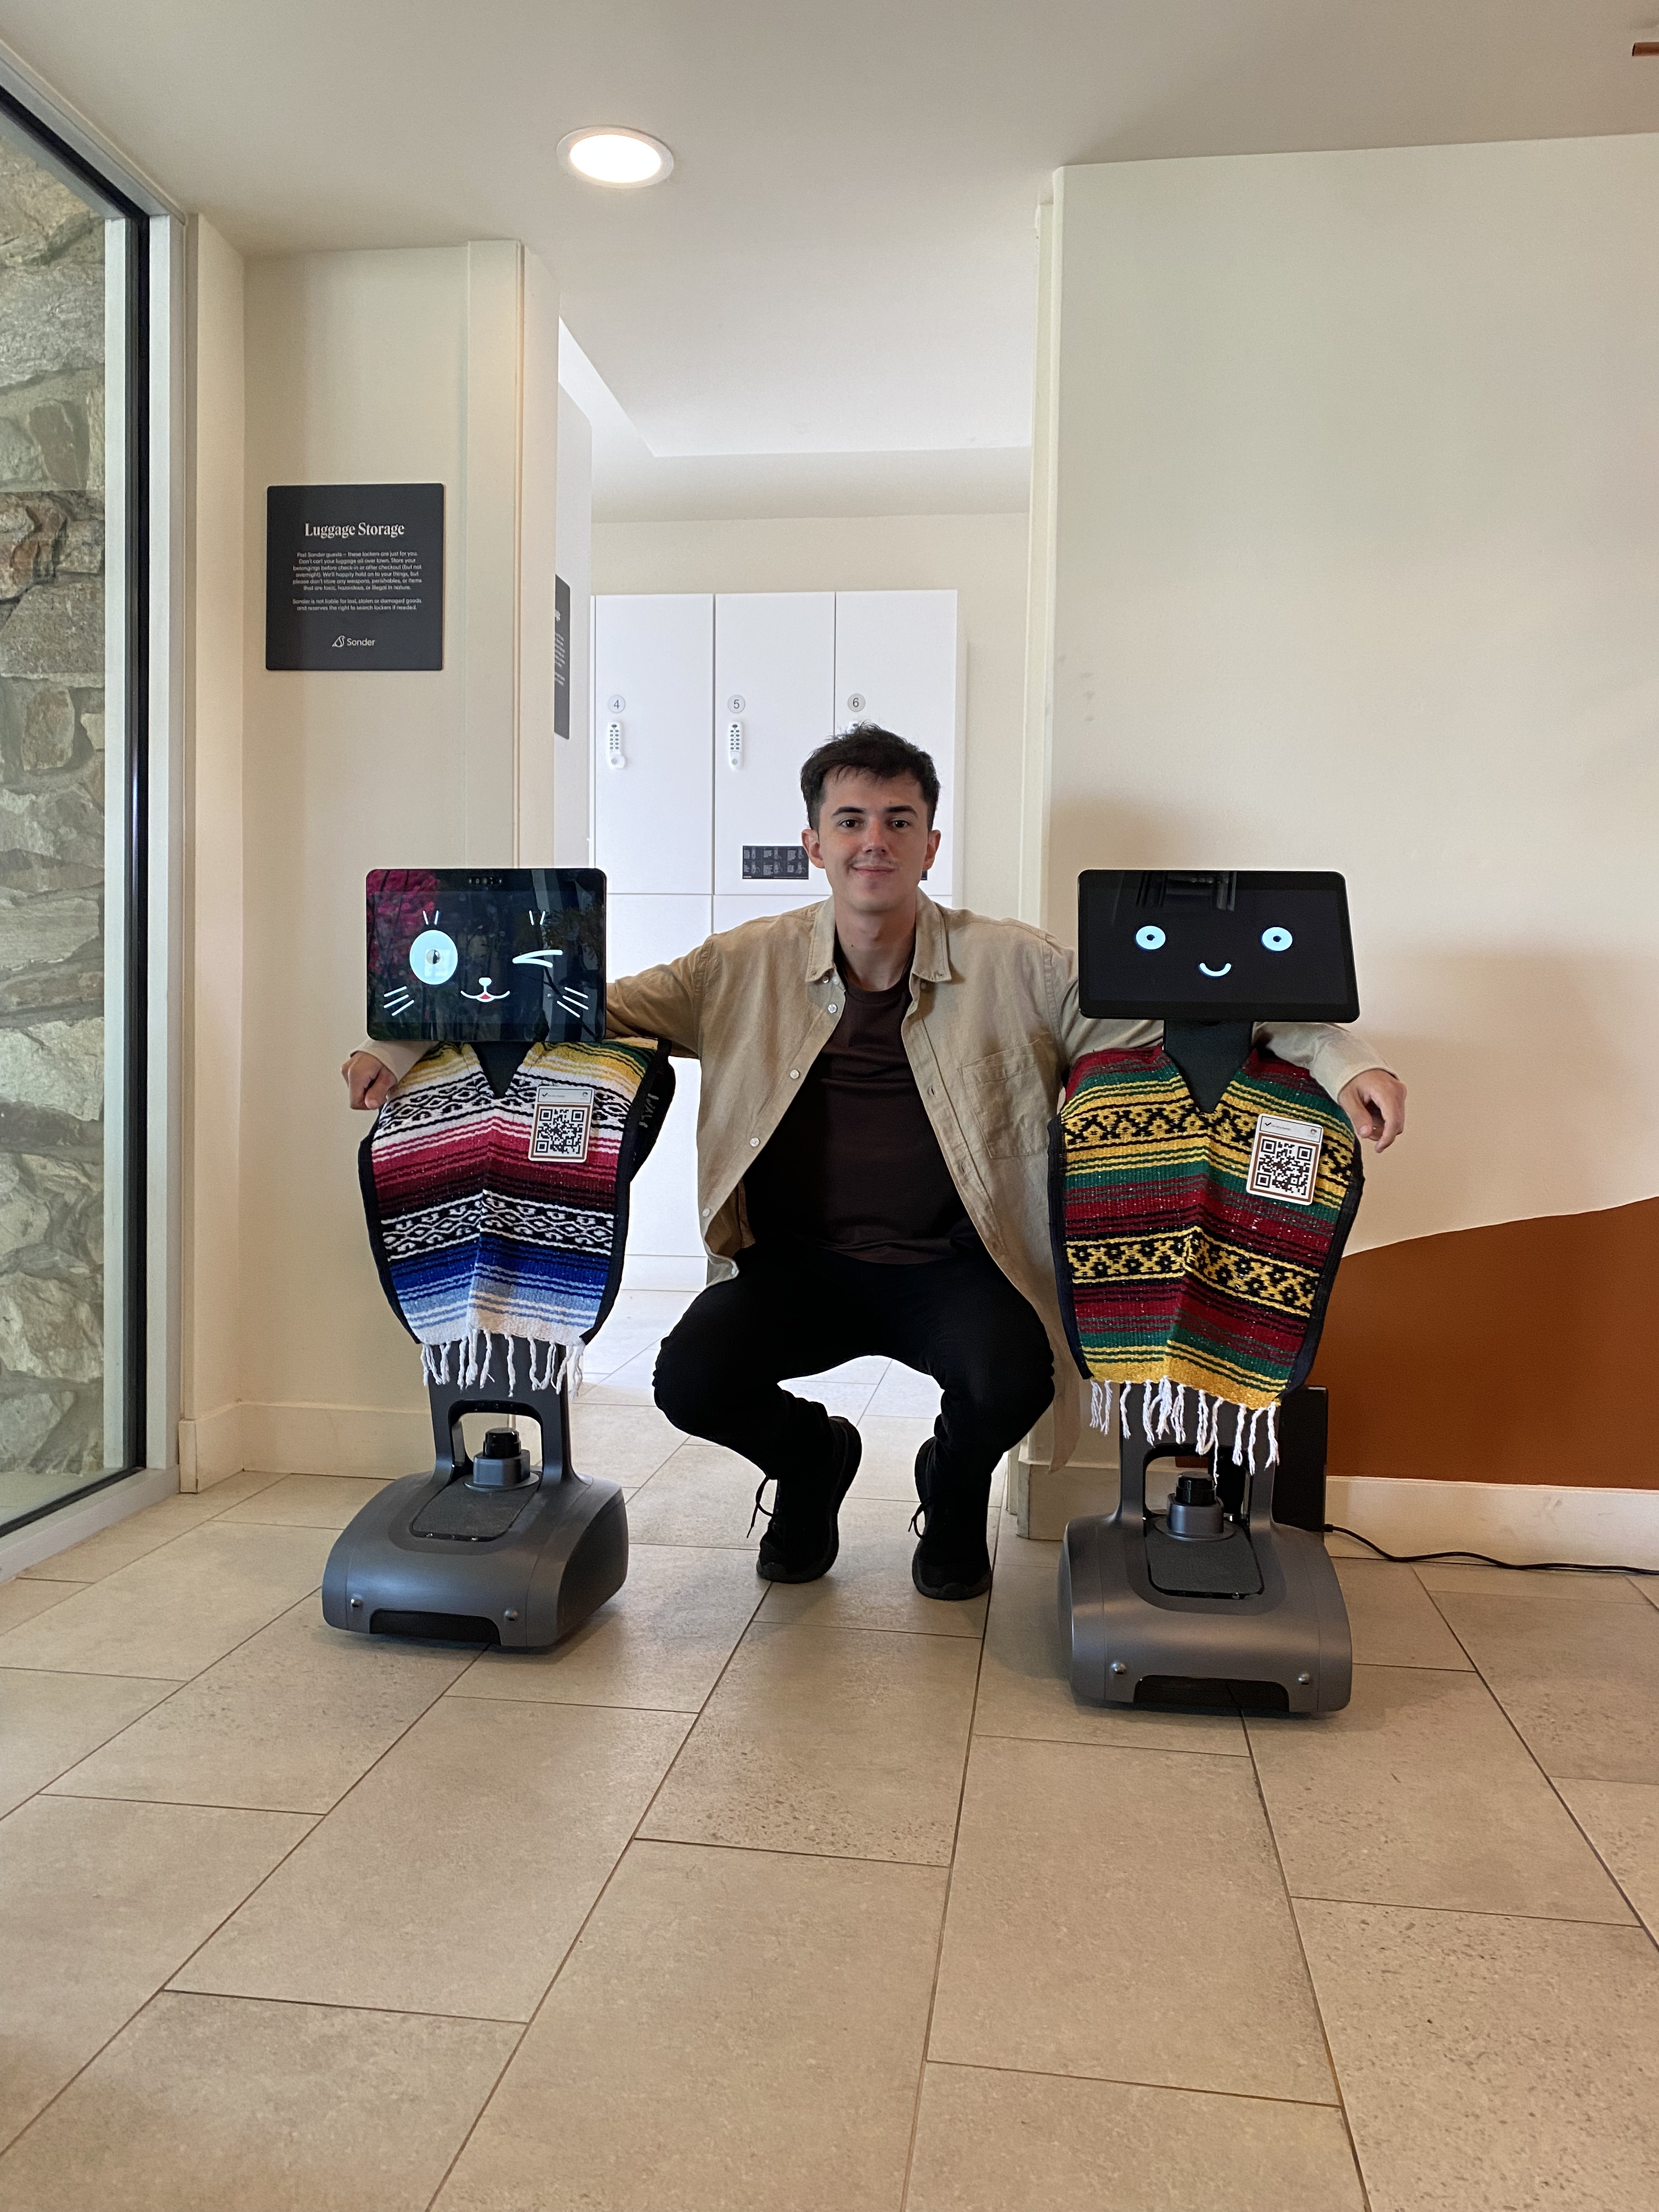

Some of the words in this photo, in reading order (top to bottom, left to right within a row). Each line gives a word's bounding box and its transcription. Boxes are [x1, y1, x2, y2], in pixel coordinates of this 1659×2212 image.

[305, 523, 356, 539] Luggage
[358, 522, 404, 538] Storage
[347, 637, 375, 646] Sonder
[613, 699, 620, 709] 4
[733, 699, 740, 709] 5
[853, 697, 859, 708] 6
